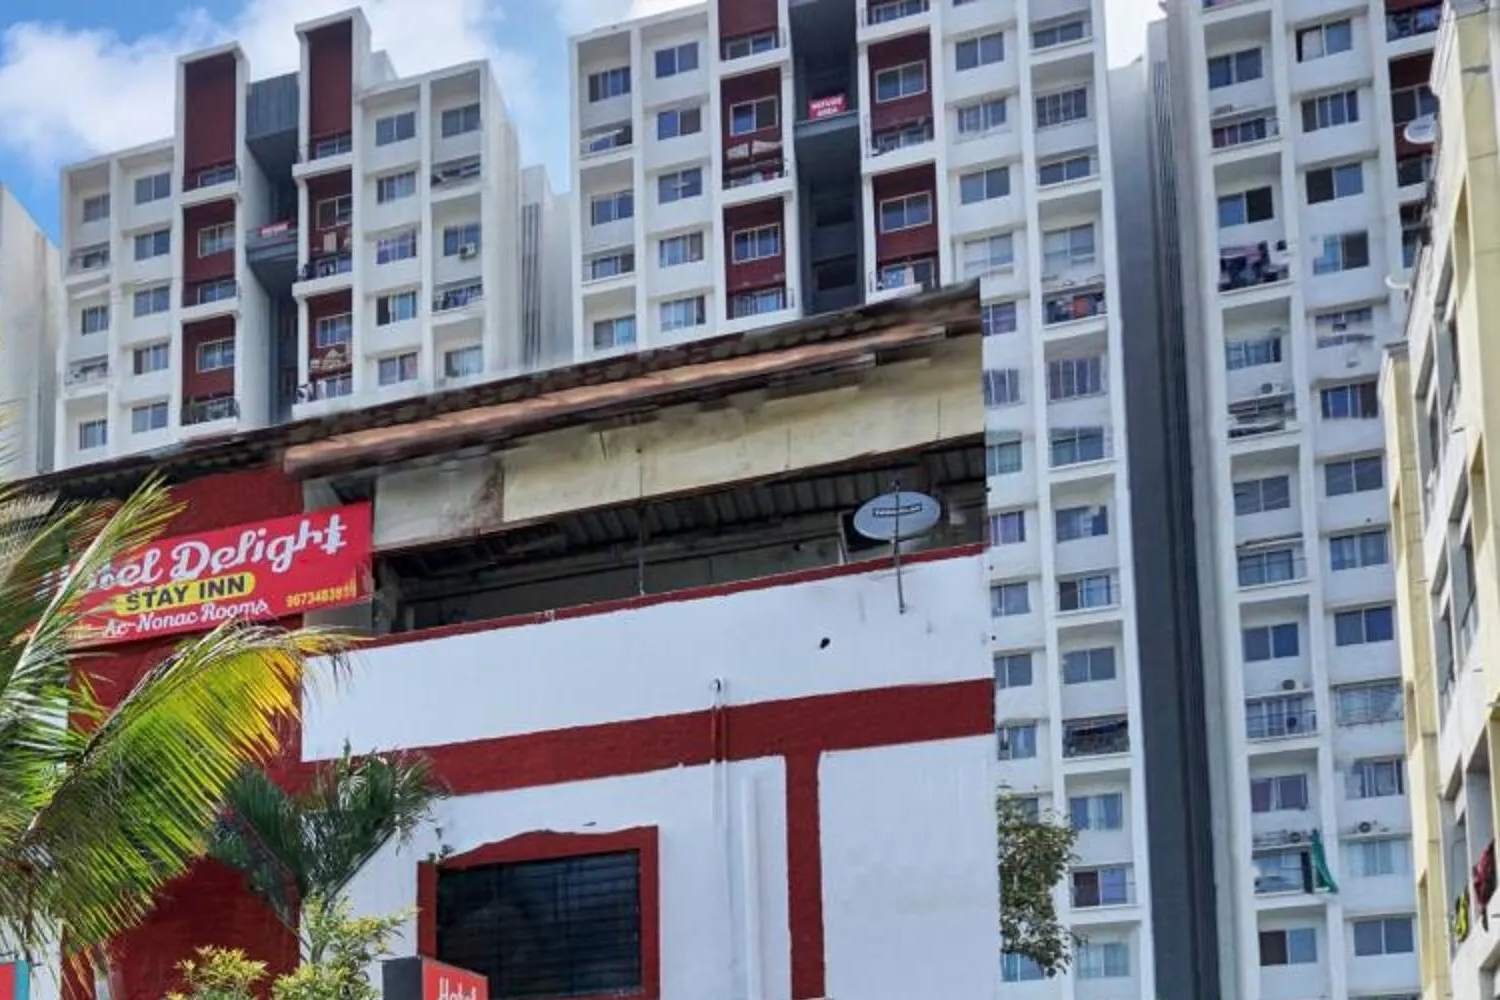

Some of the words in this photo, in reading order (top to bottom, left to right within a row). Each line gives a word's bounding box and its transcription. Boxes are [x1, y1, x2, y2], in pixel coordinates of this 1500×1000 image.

[170, 513, 348, 582] Delight
[125, 583, 188, 612] STAY
[199, 574, 246, 600] INN
[200, 600, 269, 624] Rooms
